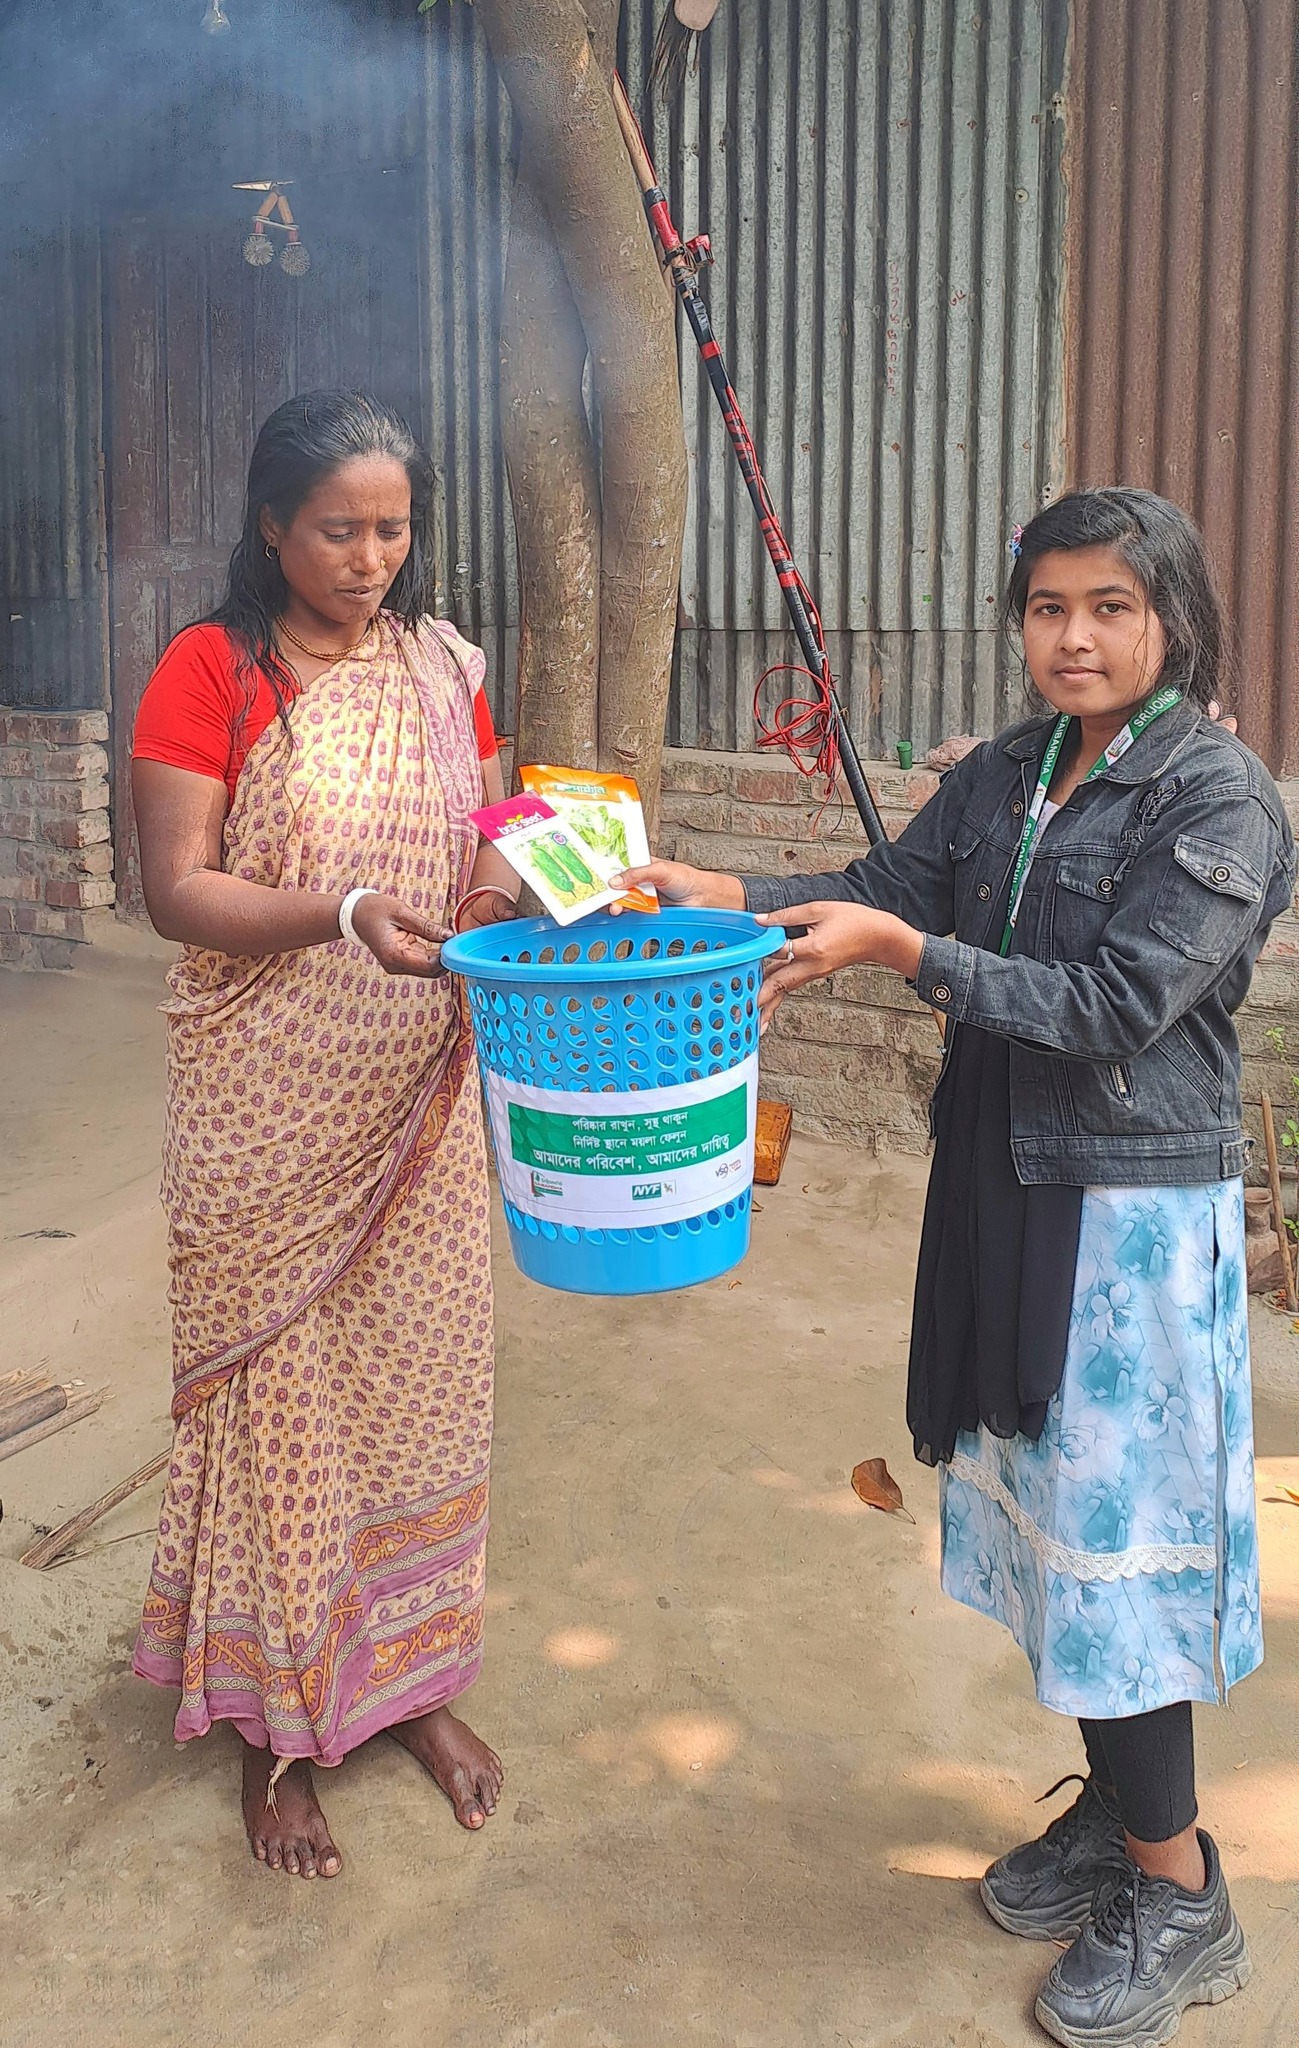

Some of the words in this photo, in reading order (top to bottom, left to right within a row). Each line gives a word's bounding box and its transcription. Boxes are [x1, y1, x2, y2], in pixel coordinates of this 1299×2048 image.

[1133, 686, 1181, 727] SRIJONSH
[1041, 715, 1069, 775] GAIBANDHA
[496, 821, 522, 836] brac
[522, 811, 545, 827] seed
[662, 1112, 688, 1126] থাকুন
[533, 1149, 581, 1169] আমাদের
[646, 1145, 698, 1166] আমাদের
[701, 1133, 730, 1155] দায়িত্ব
[573, 1135, 601, 1149] নির্দিষ্ট
[603, 1138, 627, 1150] স্থানে
[660, 1130, 687, 1144] ফেলুন
[633, 1183, 660, 1197] NYF
